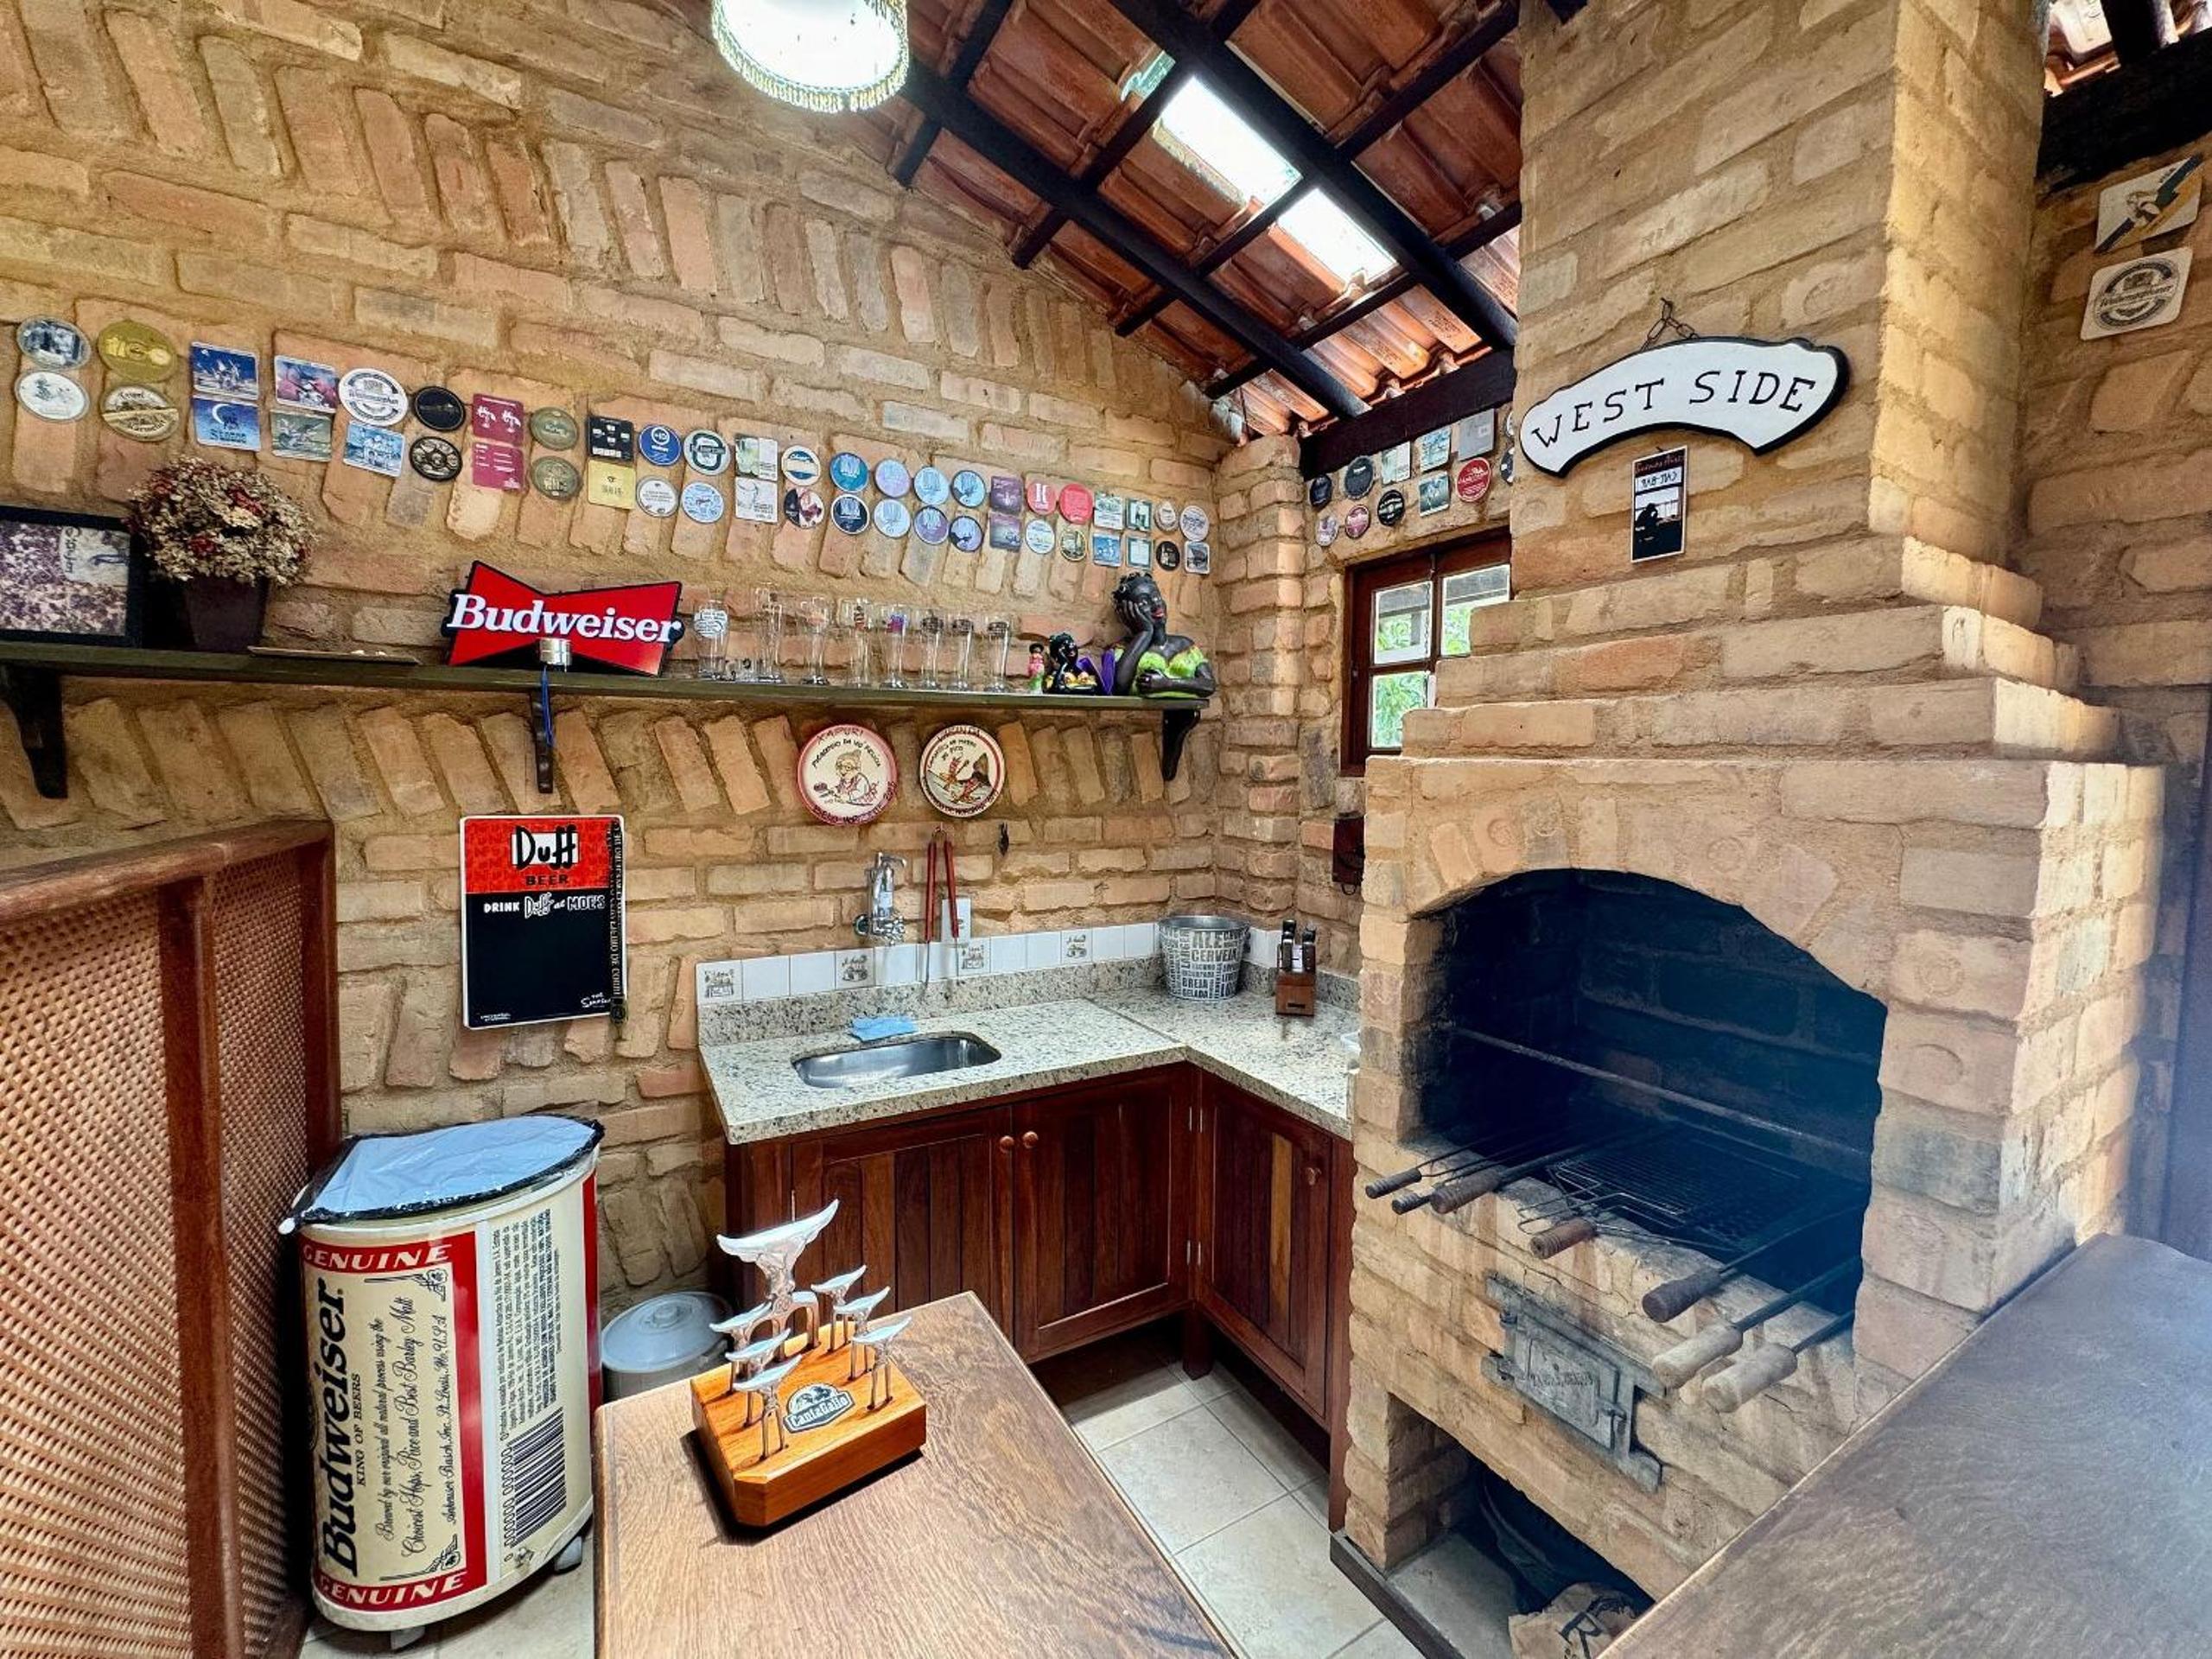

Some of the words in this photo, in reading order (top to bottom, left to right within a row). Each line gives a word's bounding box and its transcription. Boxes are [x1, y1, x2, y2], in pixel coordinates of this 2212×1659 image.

[1531, 378, 1664, 448] WEST
[1689, 370, 1815, 412] SIDE
[447, 594, 682, 643] Budweiser
[515, 824, 576, 869] Duff
[525, 874, 569, 886] BEER
[483, 901, 519, 913] DRINK
[303, 1244, 452, 1269] GENUINE
[389, 1297, 416, 1333] Malt
[391, 1336, 424, 1382] Barley
[352, 1373, 362, 1420] BEERS
[393, 1382, 420, 1416] Best
[315, 1277, 357, 1578] Budweiser
[354, 1424, 364, 1444] OF
[400, 1417, 420, 1438] and
[355, 1450, 366, 1486] KING
[400, 1508, 427, 1558] Choicest
[320, 1572, 467, 1605] GENUINE
